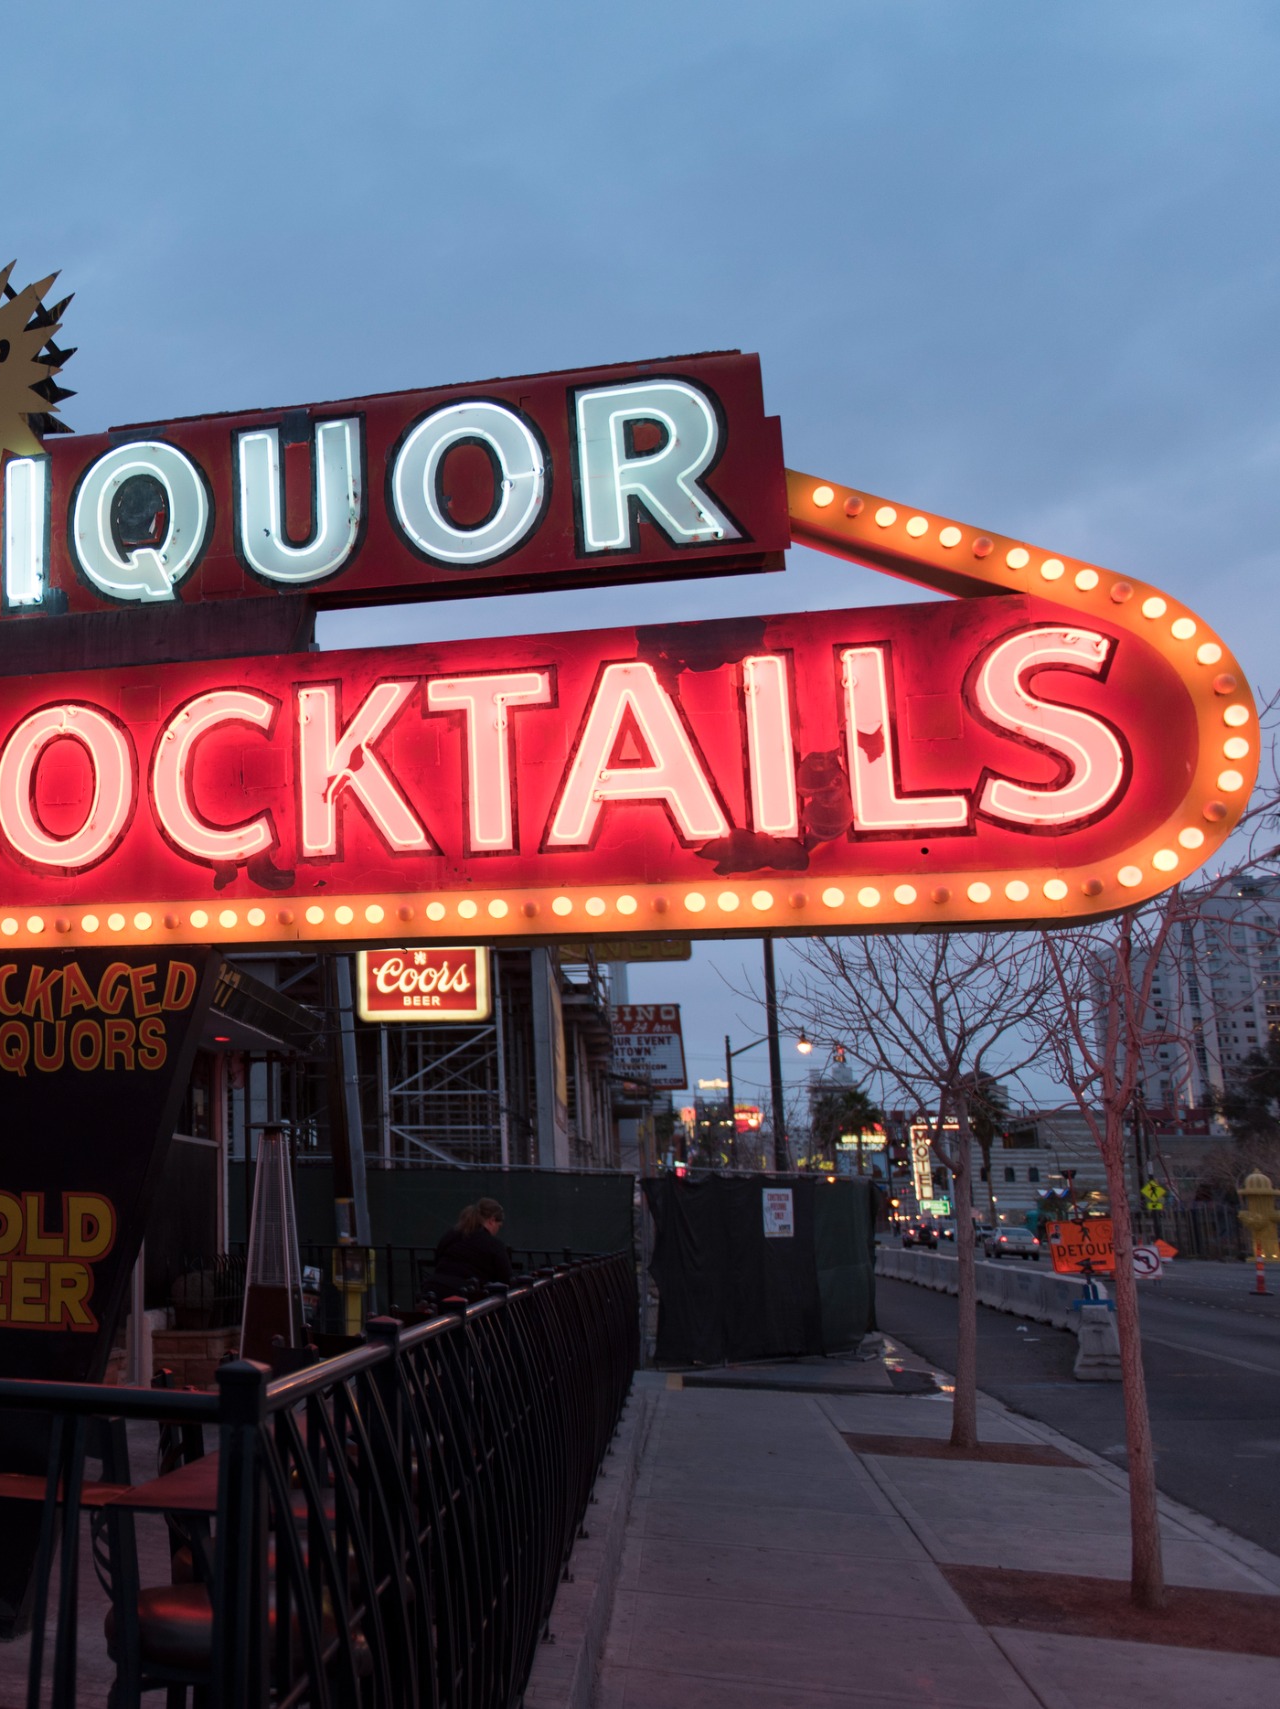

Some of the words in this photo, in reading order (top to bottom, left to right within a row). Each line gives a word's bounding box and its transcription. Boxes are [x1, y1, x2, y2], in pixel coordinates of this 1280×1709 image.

[373, 957, 470, 993] Coors
[403, 996, 441, 1006] BEER
[637, 1036, 673, 1046] EVENT
[915, 1131, 933, 1200] MOTEL
